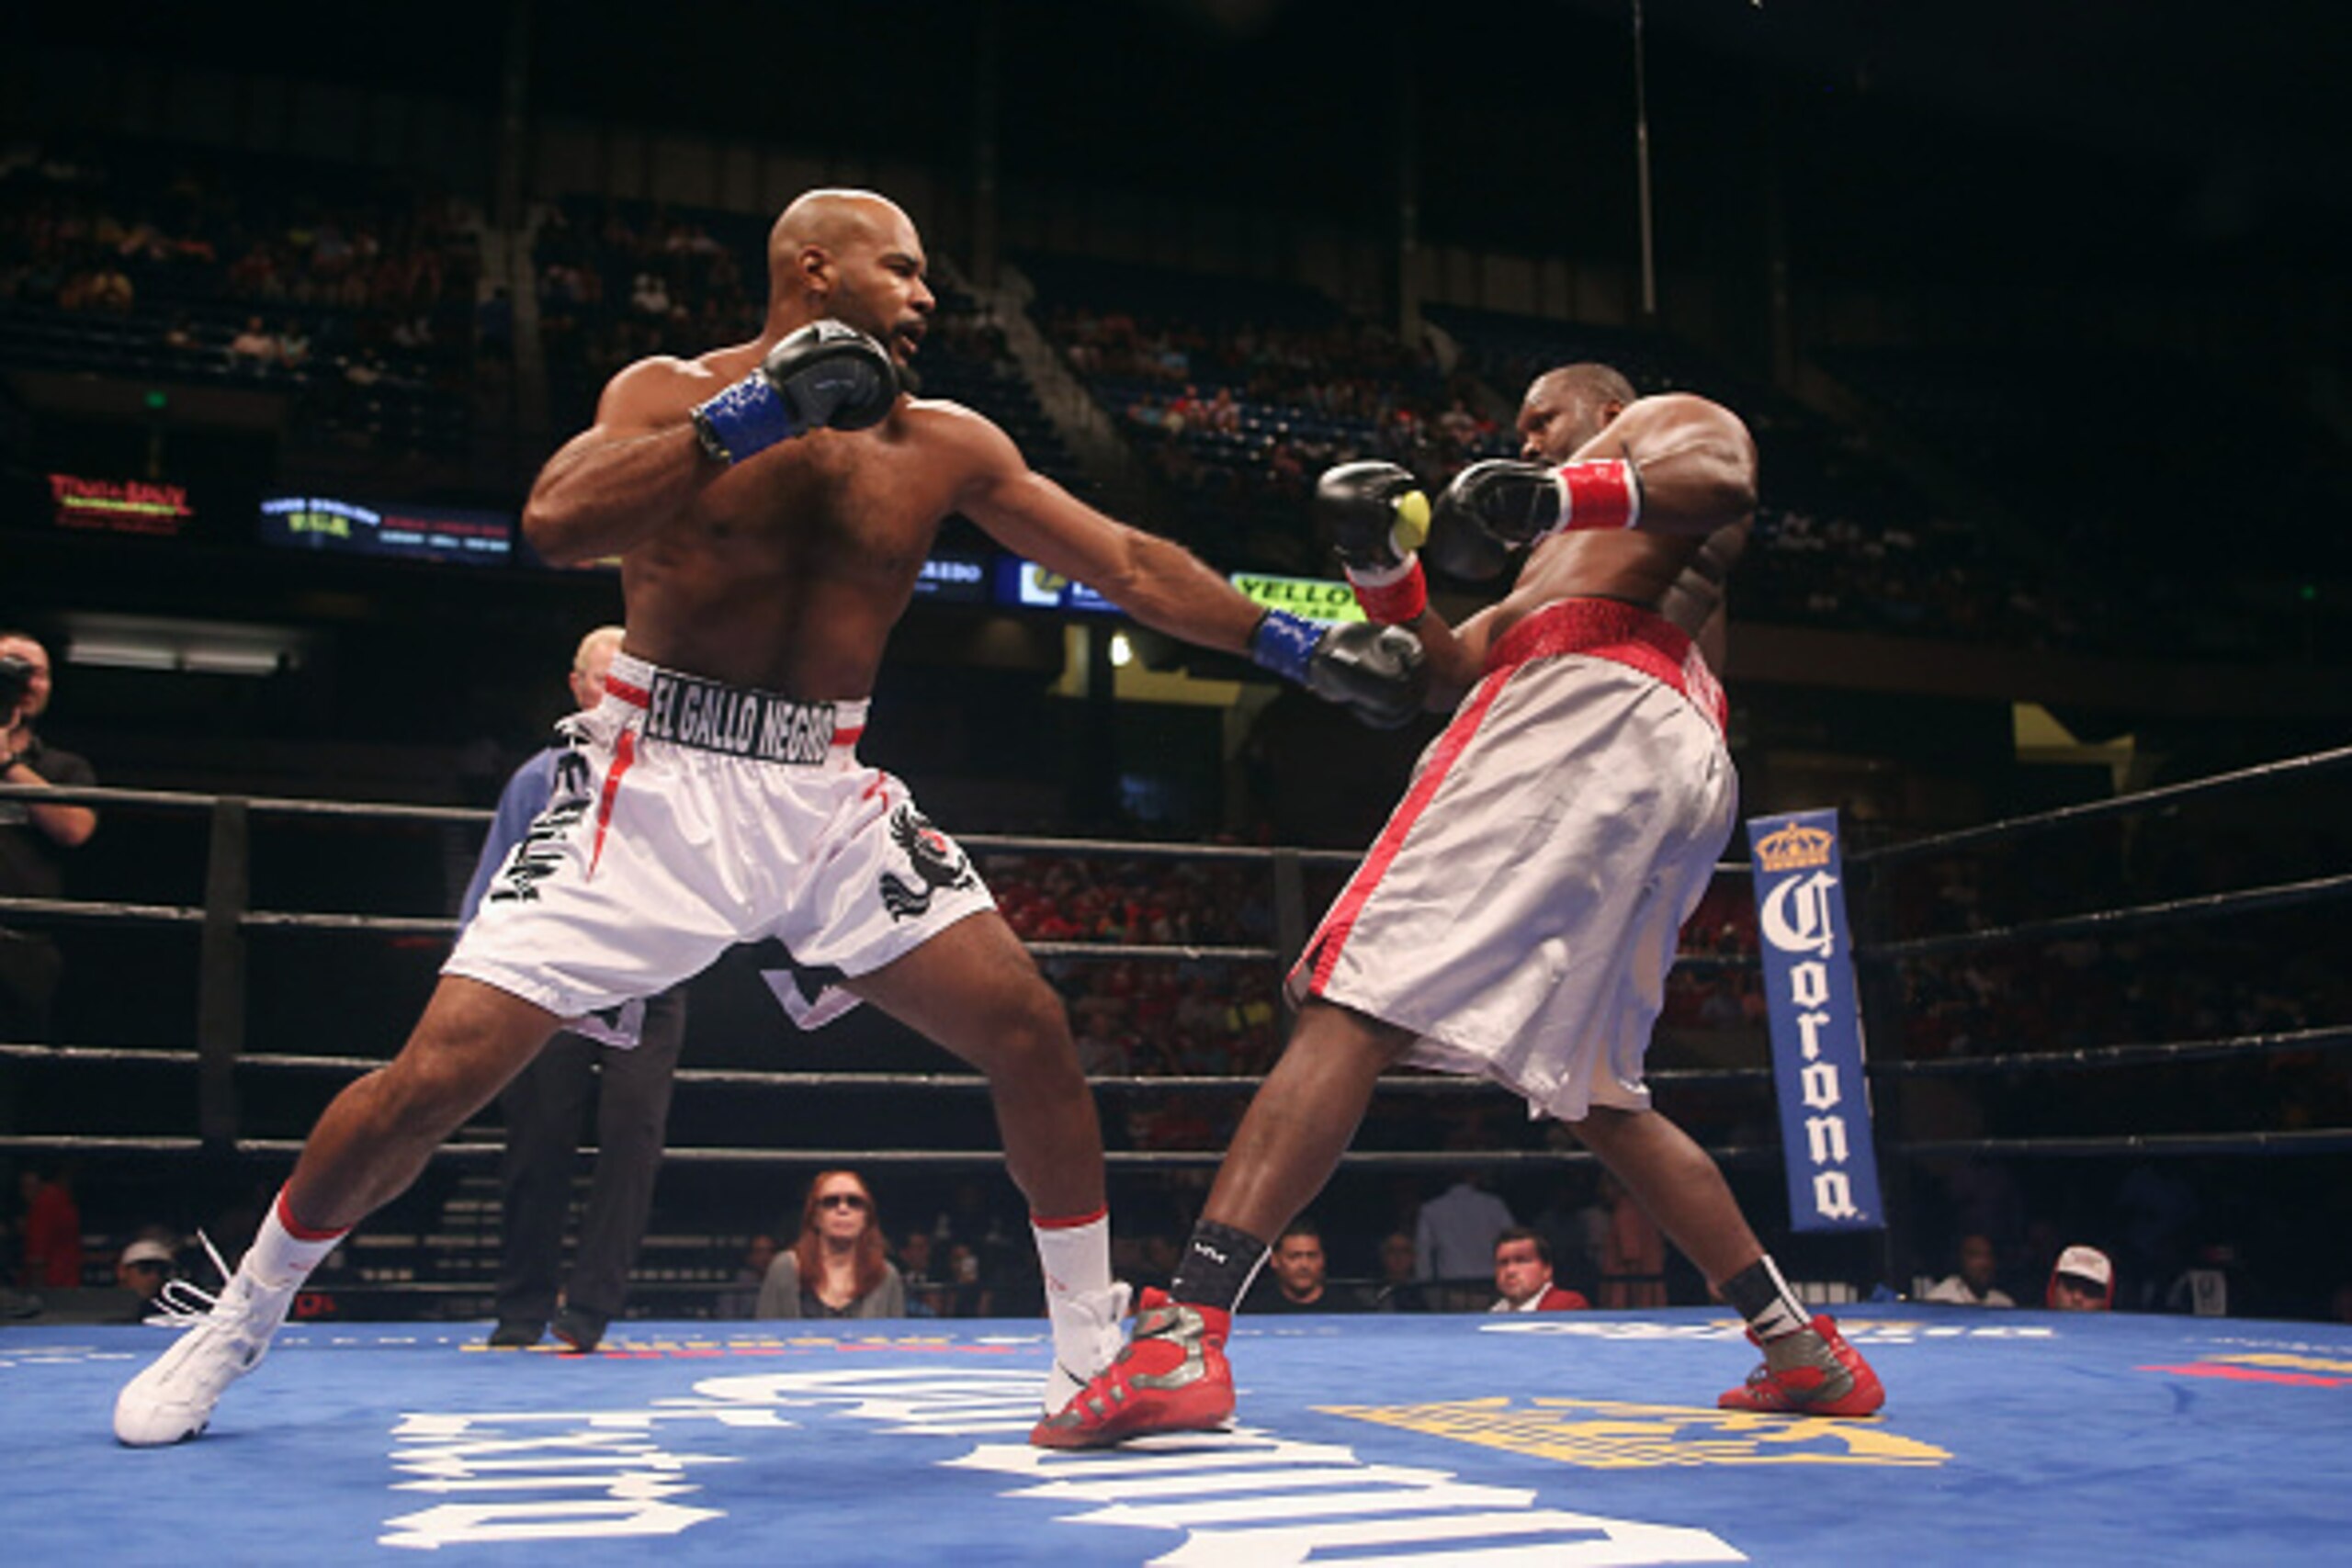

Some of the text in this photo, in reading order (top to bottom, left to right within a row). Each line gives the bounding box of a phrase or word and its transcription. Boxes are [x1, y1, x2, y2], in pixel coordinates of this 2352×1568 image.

[1242, 579, 1359, 605] YELLO
[649, 676, 833, 761] EL GALLO NEGRO
[1760, 870, 1857, 1221] Corona
[378, 1410, 803, 1549] Extra
